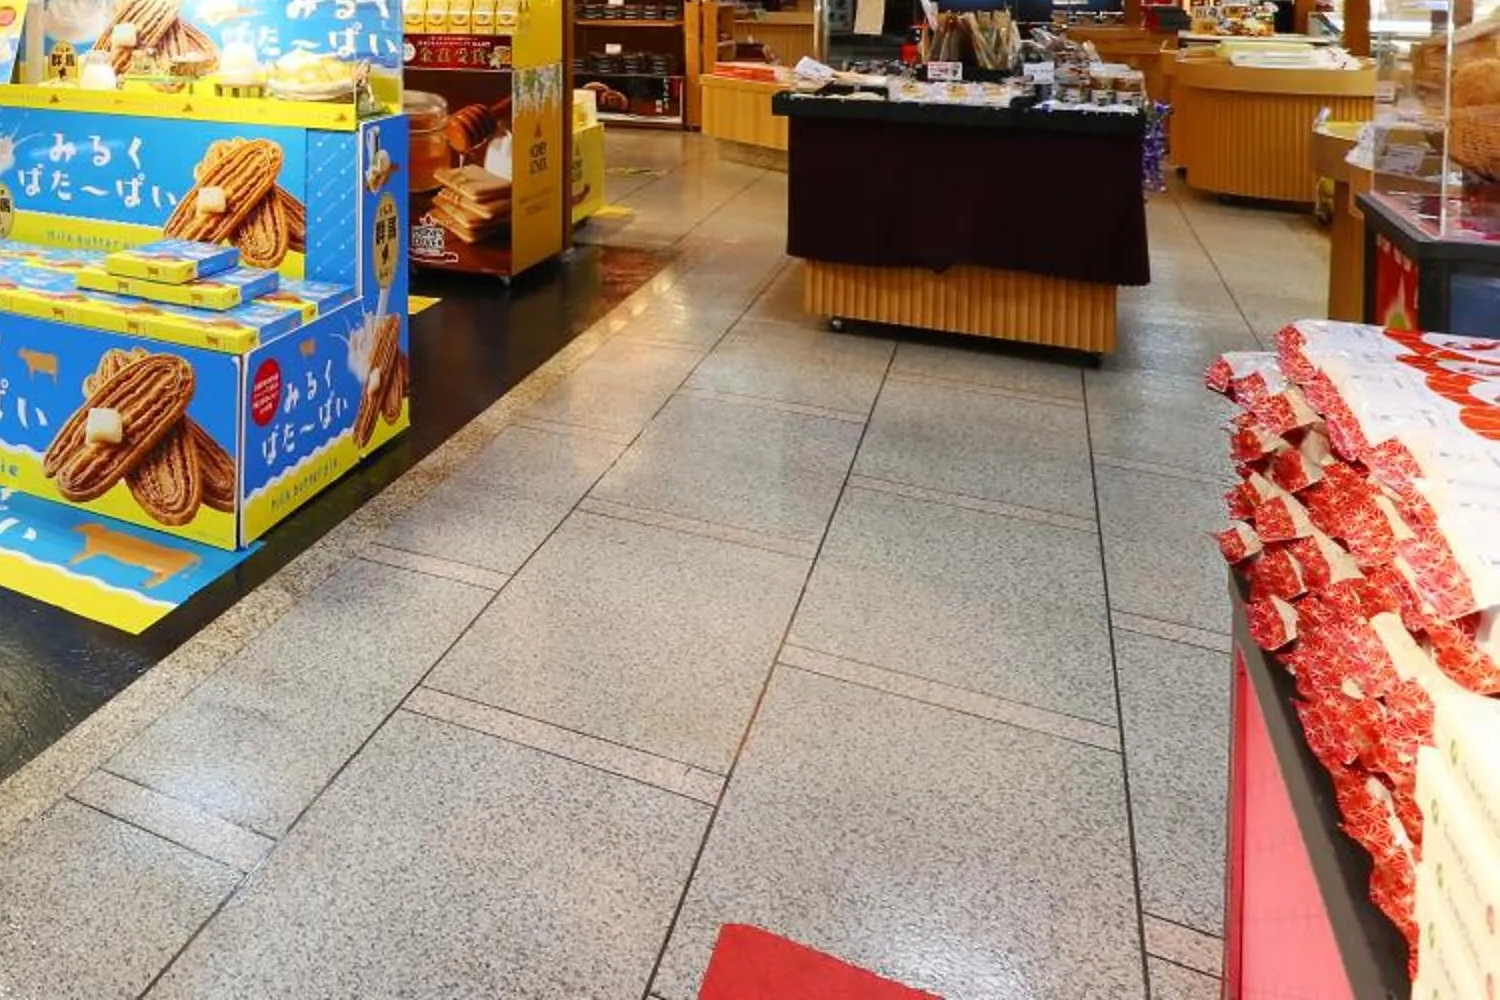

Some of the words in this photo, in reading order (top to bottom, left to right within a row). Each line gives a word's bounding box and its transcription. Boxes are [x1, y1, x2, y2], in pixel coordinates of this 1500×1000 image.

[49, 132, 143, 170] みるく
[284, 358, 333, 408] みるく
